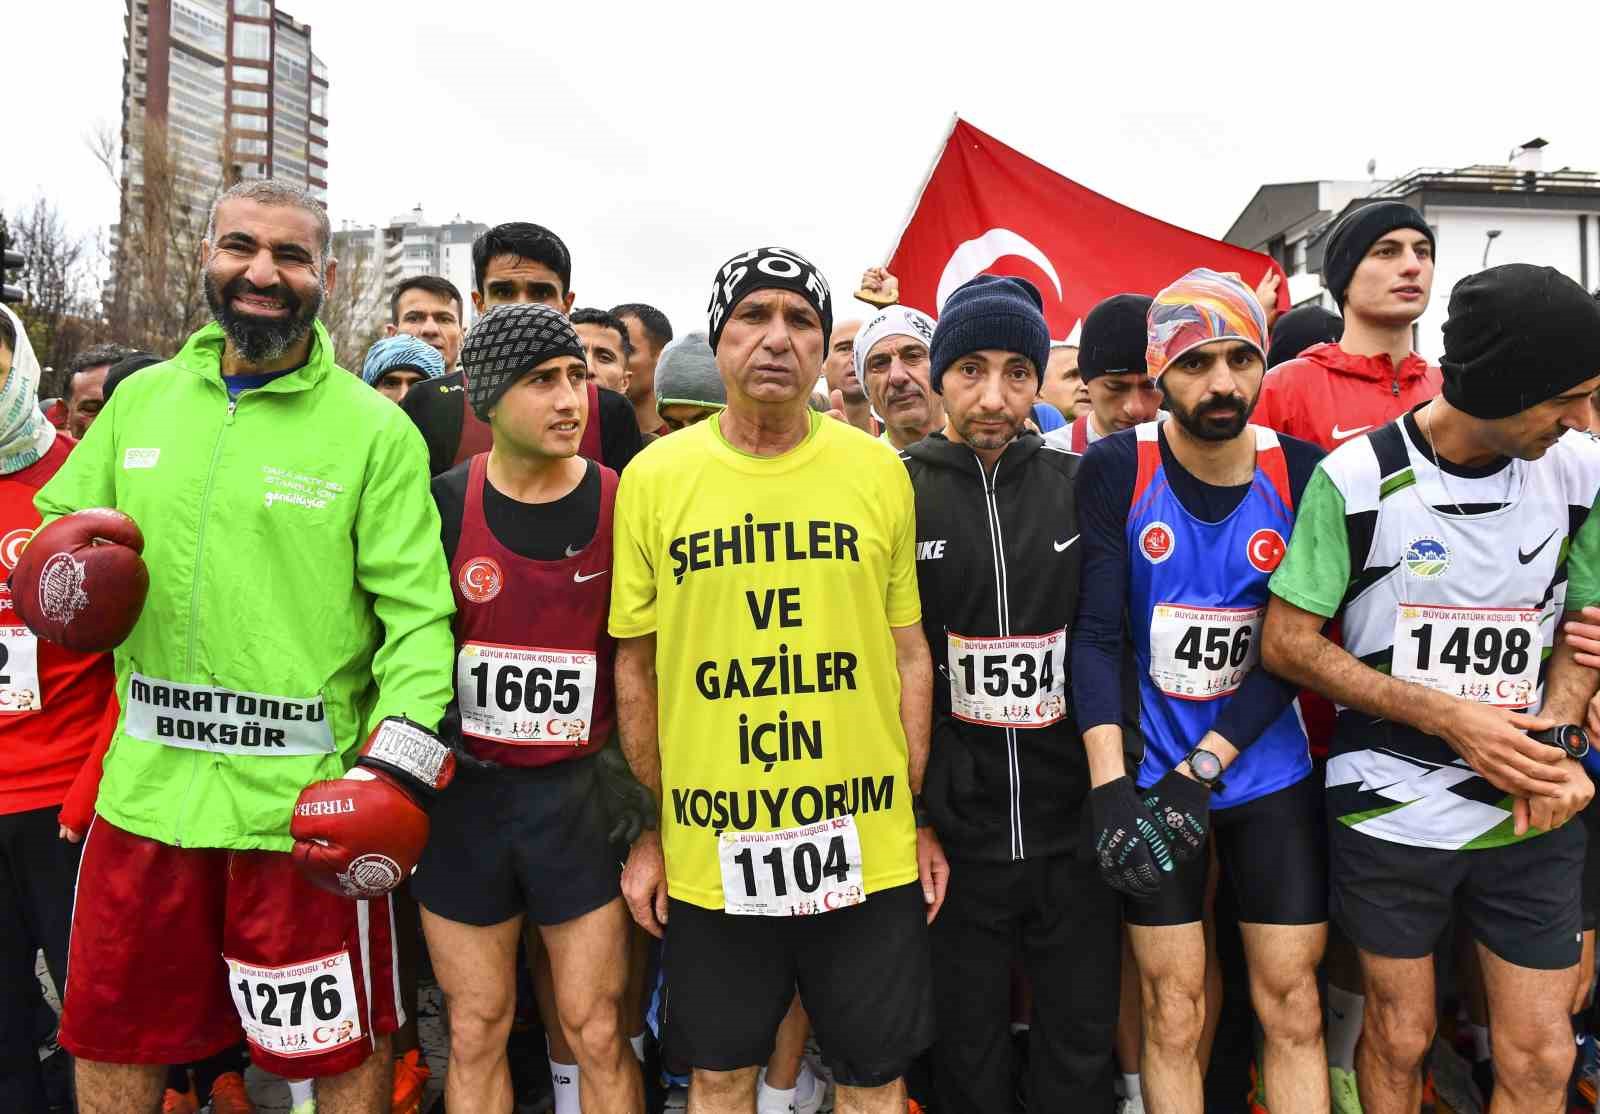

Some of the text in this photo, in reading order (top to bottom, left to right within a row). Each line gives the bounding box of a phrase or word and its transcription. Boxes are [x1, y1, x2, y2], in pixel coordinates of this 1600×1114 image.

[669, 513, 860, 585] ŞEHİTLER
[916, 540, 947, 560] IKE
[745, 587, 803, 630] VE
[1422, 609, 1450, 620] BÜYÜK
[1451, 613, 1485, 621] ATATÜRK
[695, 643, 858, 700] GAZİLER
[958, 649, 1054, 699] 1534
[1174, 626, 1253, 671] 456
[1411, 623, 1531, 676] 1498
[131, 679, 325, 723] MARATONCU
[470, 662, 581, 715] 1665
[156, 715, 286, 748] BOKSÖR
[739, 710, 823, 772] İÇİN
[672, 775, 895, 837] KOŞUYORUM
[734, 835, 850, 897] 1104
[238, 974, 341, 1027] 1276
